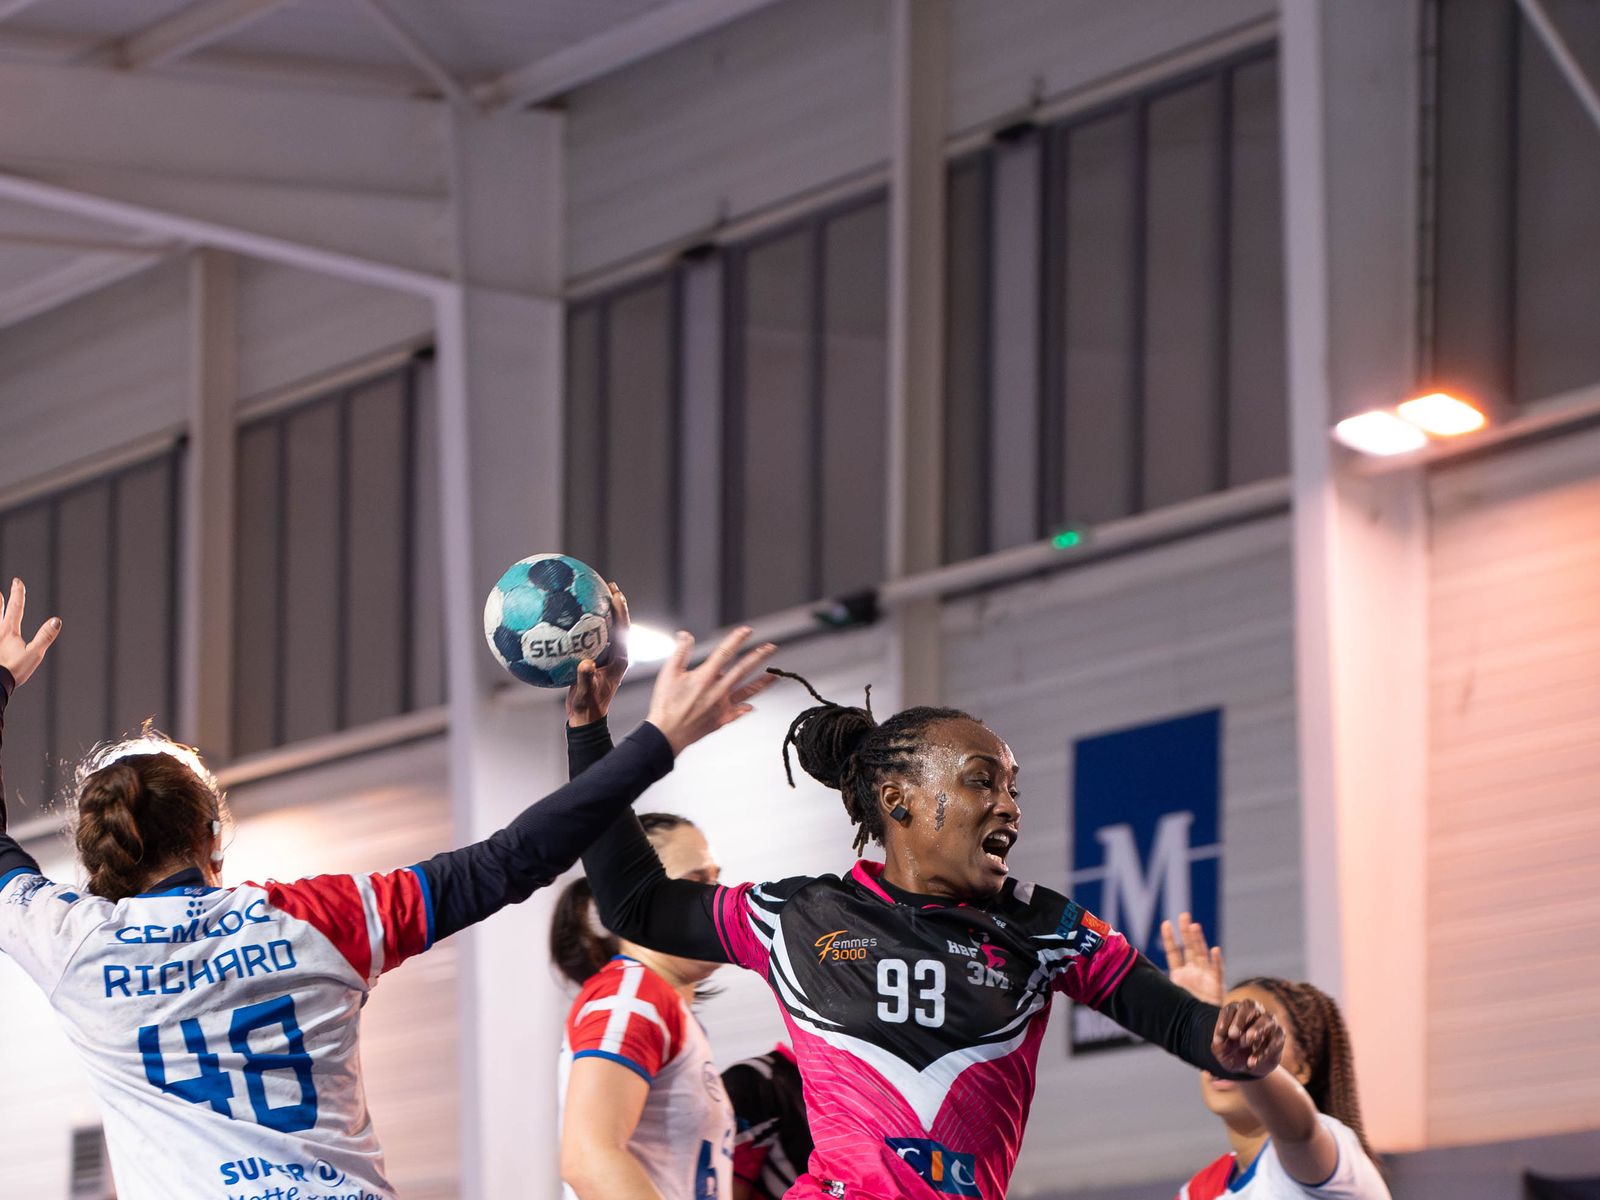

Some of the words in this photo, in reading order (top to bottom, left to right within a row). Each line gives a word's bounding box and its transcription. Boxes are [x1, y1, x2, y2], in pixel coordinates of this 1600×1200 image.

[530, 628, 602, 659] SELECT
[814, 929, 878, 966] Femmes
[831, 948, 867, 961] 3000
[103, 939, 297, 998] RICHARD
[966, 960, 1009, 990] 3M
[876, 957, 946, 1029] 93
[138, 993, 318, 1134] 48
[896, 1146, 976, 1188] CIC
